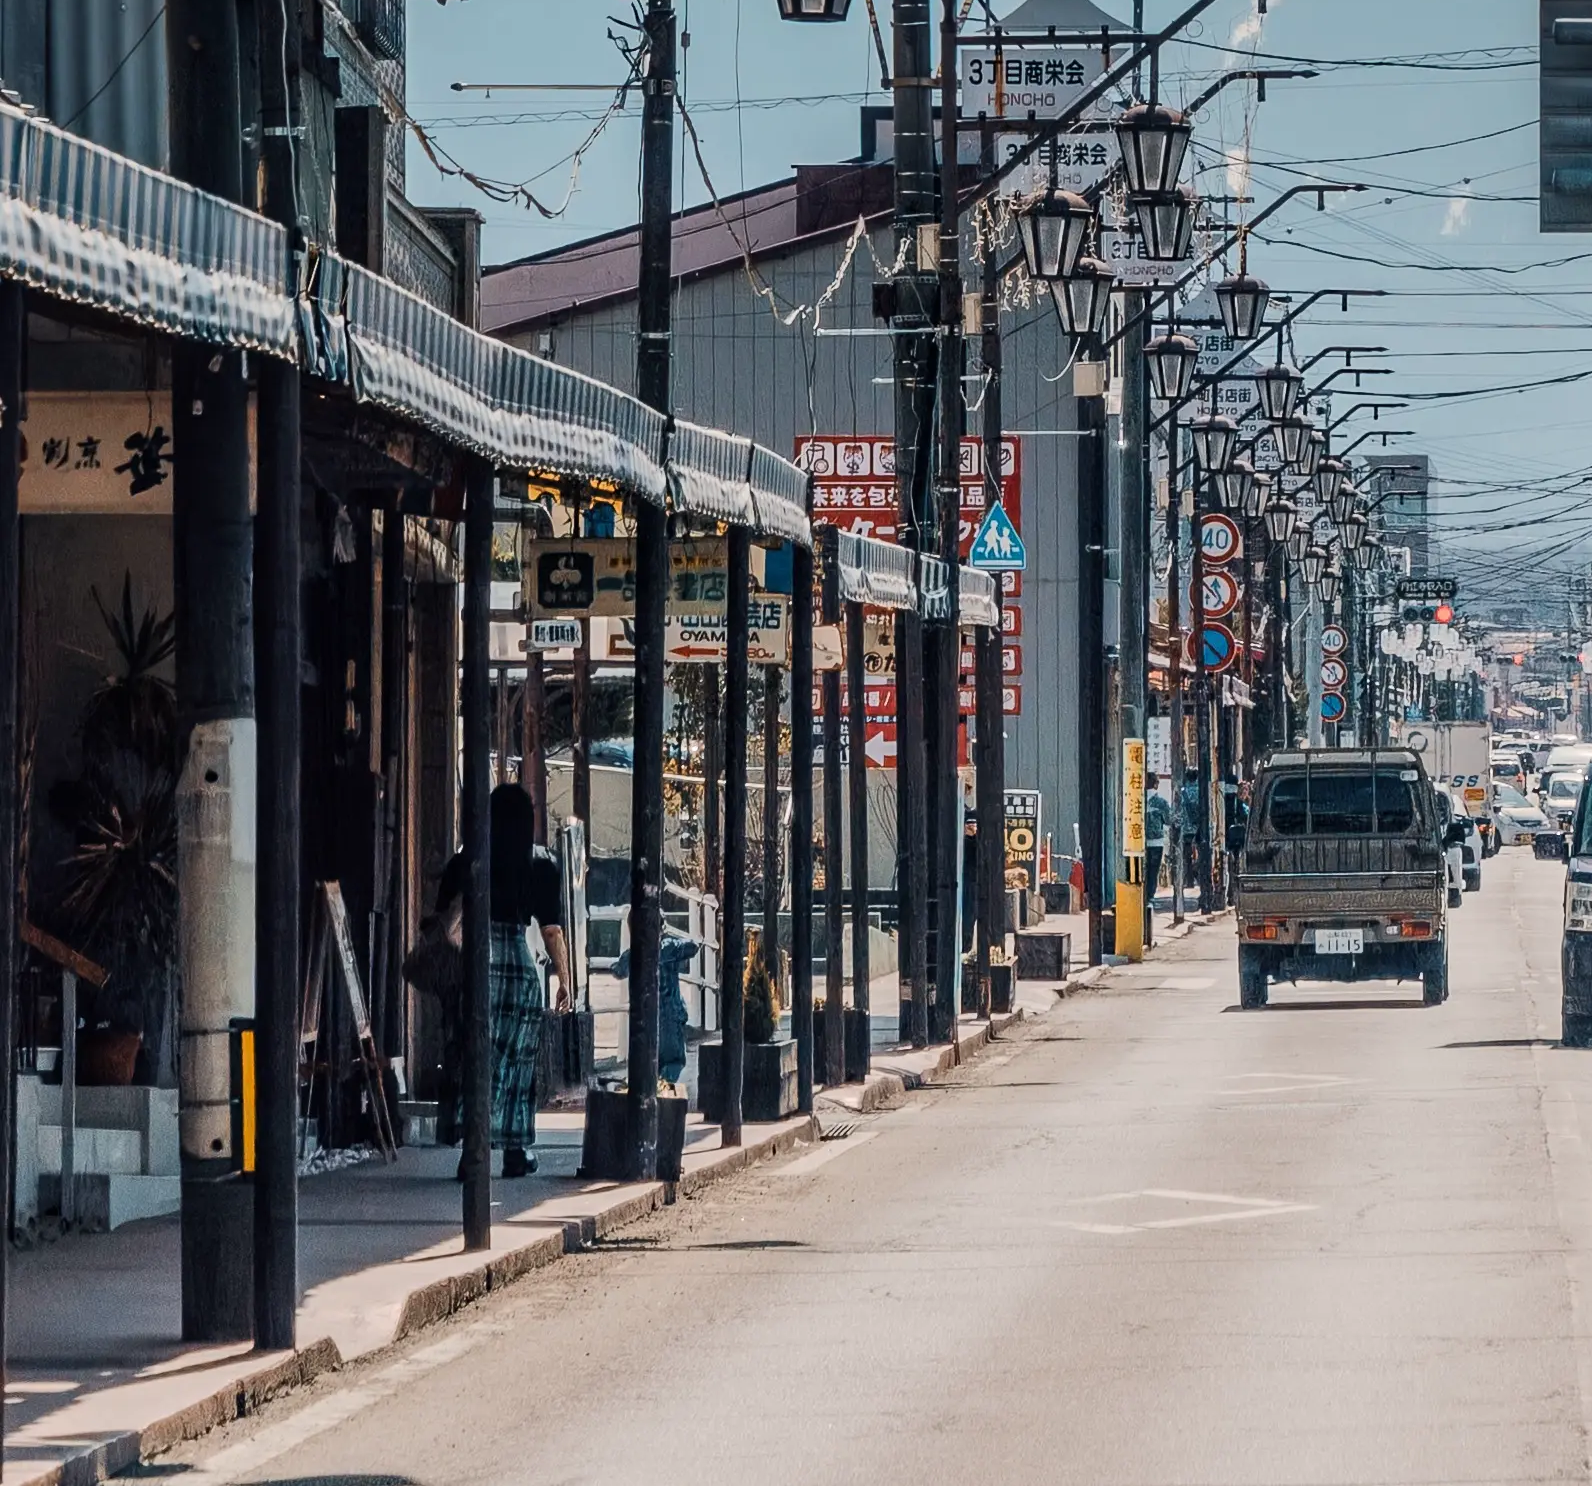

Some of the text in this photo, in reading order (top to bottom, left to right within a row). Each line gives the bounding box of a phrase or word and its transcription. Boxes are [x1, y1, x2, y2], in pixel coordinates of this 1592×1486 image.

[968, 58, 1085, 87] 3丁目商栄会
[1202, 529, 1229, 550] 40
[1324, 634, 1340, 647] 40
[1129, 745, 1144, 840] 電柱注意
